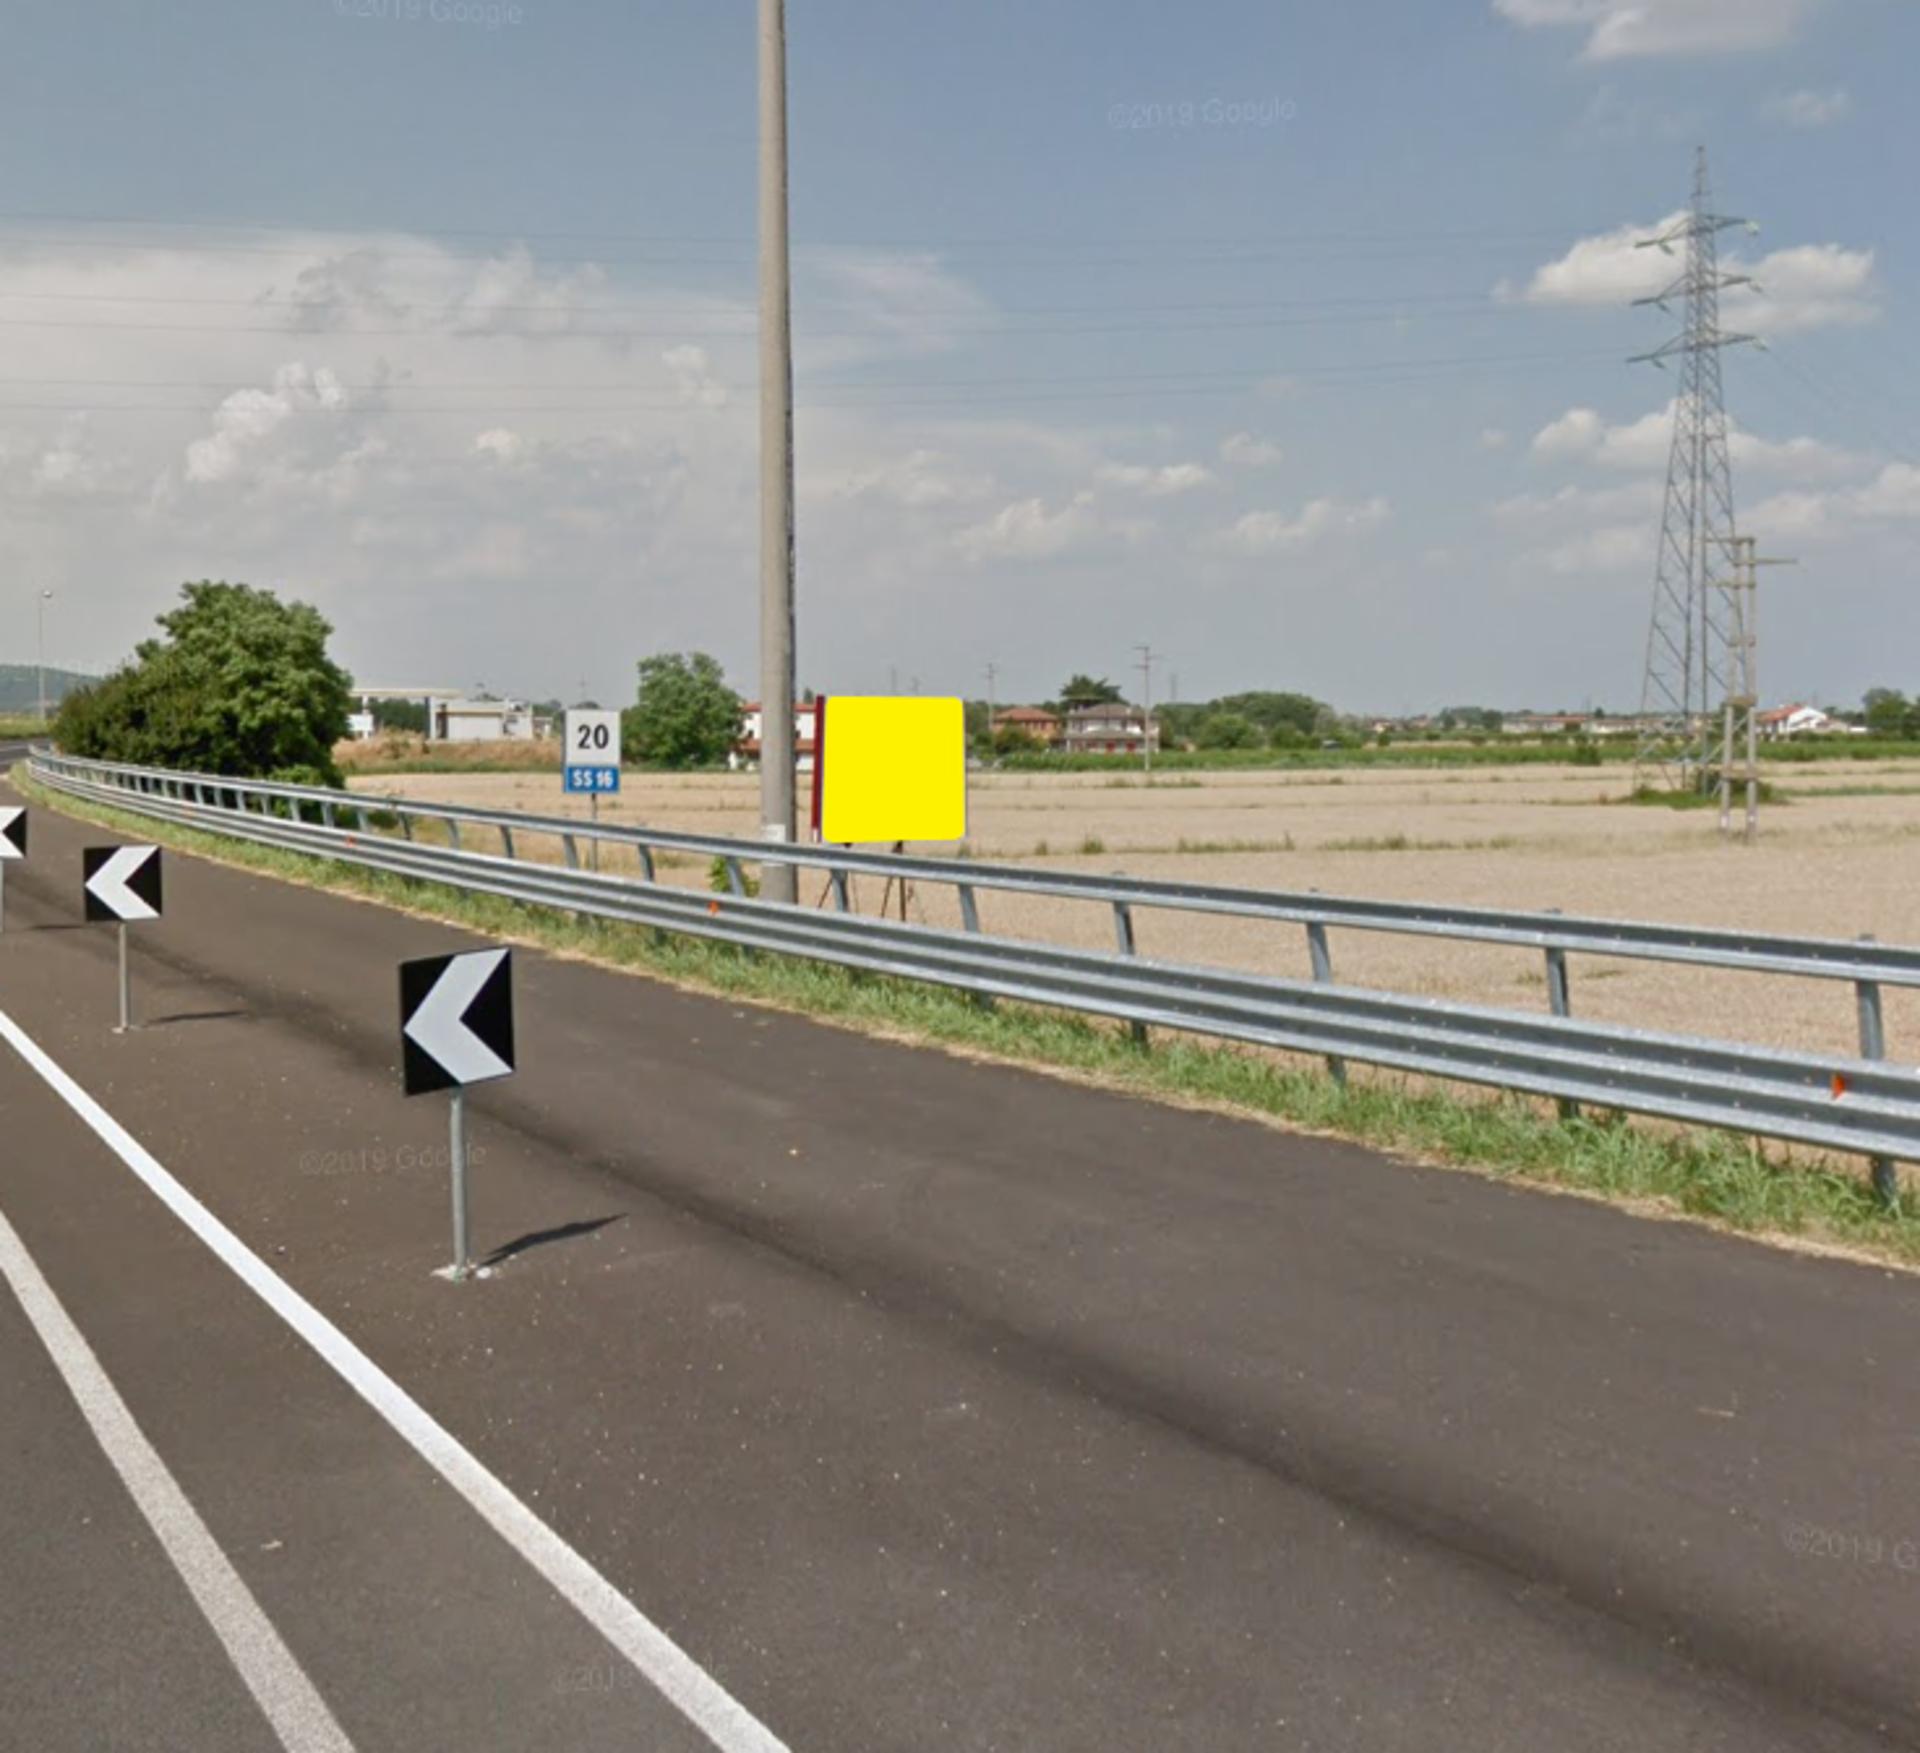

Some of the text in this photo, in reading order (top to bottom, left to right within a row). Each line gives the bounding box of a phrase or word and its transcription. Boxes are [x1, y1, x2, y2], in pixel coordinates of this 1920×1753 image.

[577, 724, 609, 749] 20
[573, 769, 614, 788] SS 16
